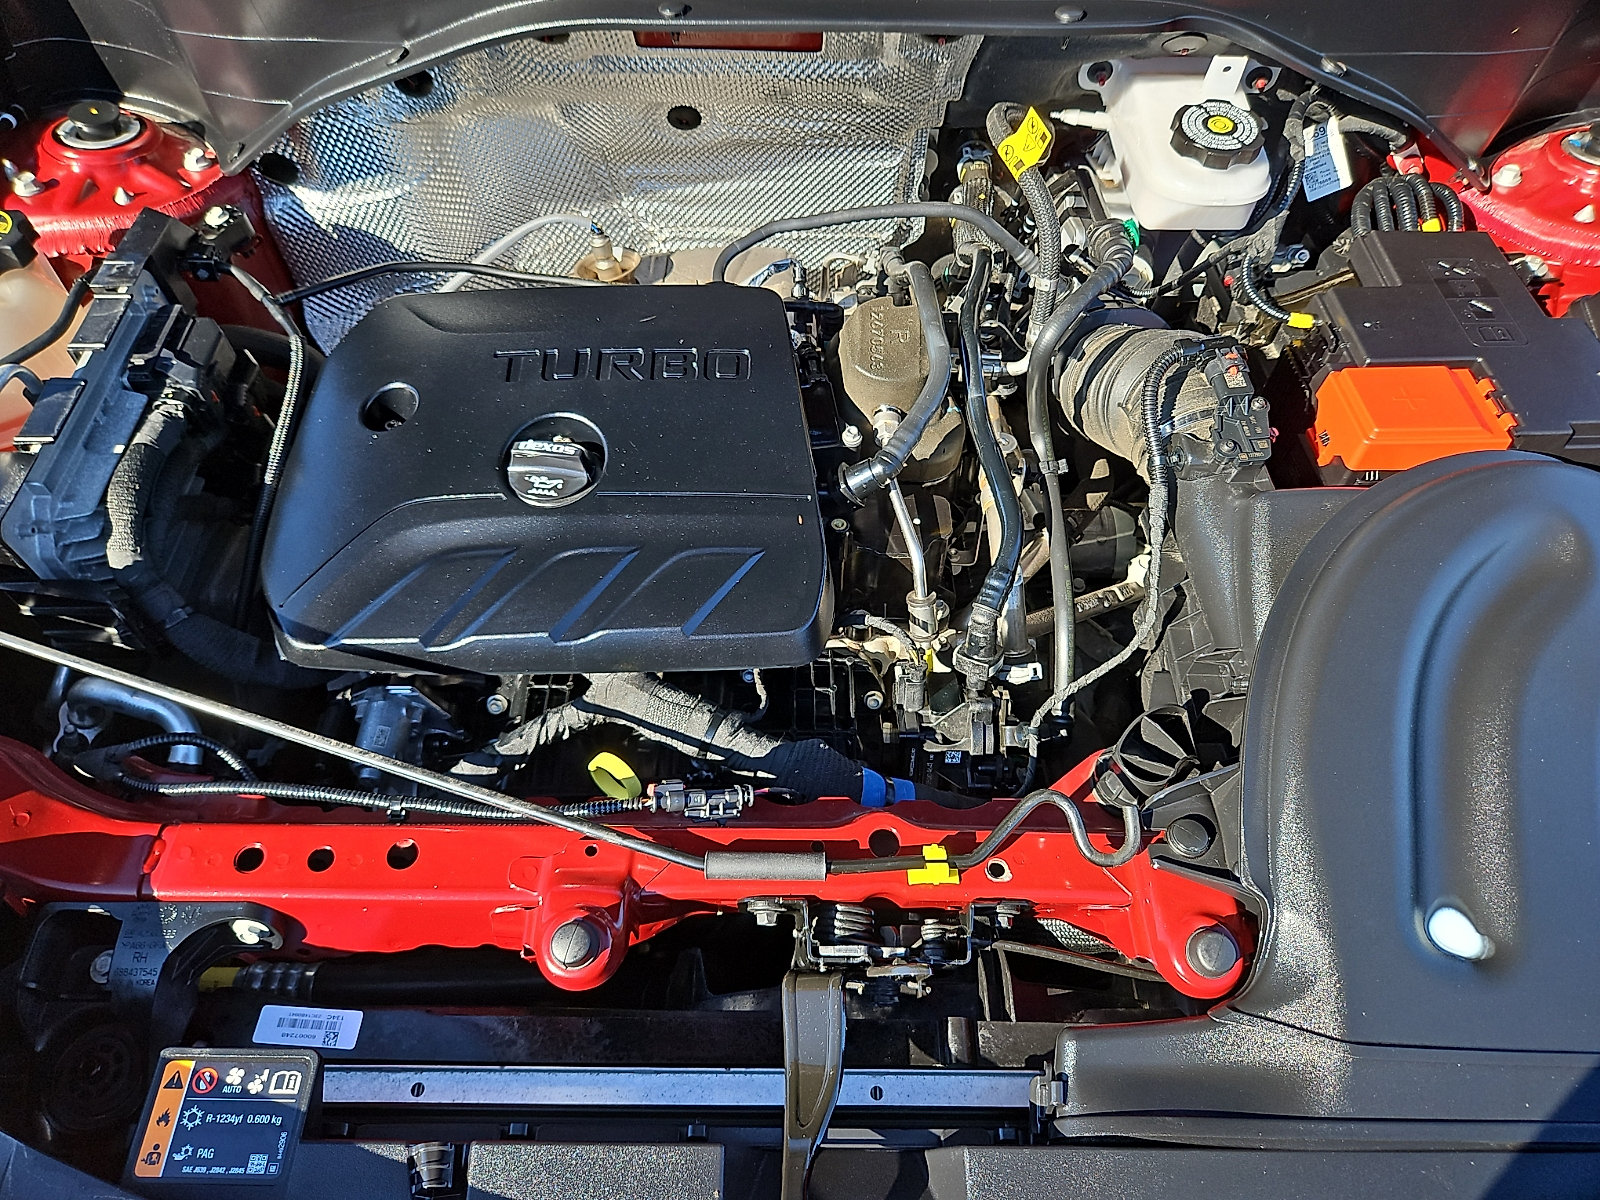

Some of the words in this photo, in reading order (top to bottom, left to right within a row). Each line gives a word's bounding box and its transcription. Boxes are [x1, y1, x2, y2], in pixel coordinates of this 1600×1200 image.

[494, 347, 752, 382] TURBO
[518, 439, 578, 455] dexos
[132, 951, 148, 963] RH
[222, 1085, 243, 1094] AUTO
[205, 1113, 243, 1126] R-1234yf
[247, 1114, 271, 1124] 0.600
[271, 1114, 283, 1126] kg
[196, 1148, 215, 1159] PAG
[181, 1165, 194, 1173] SAE
